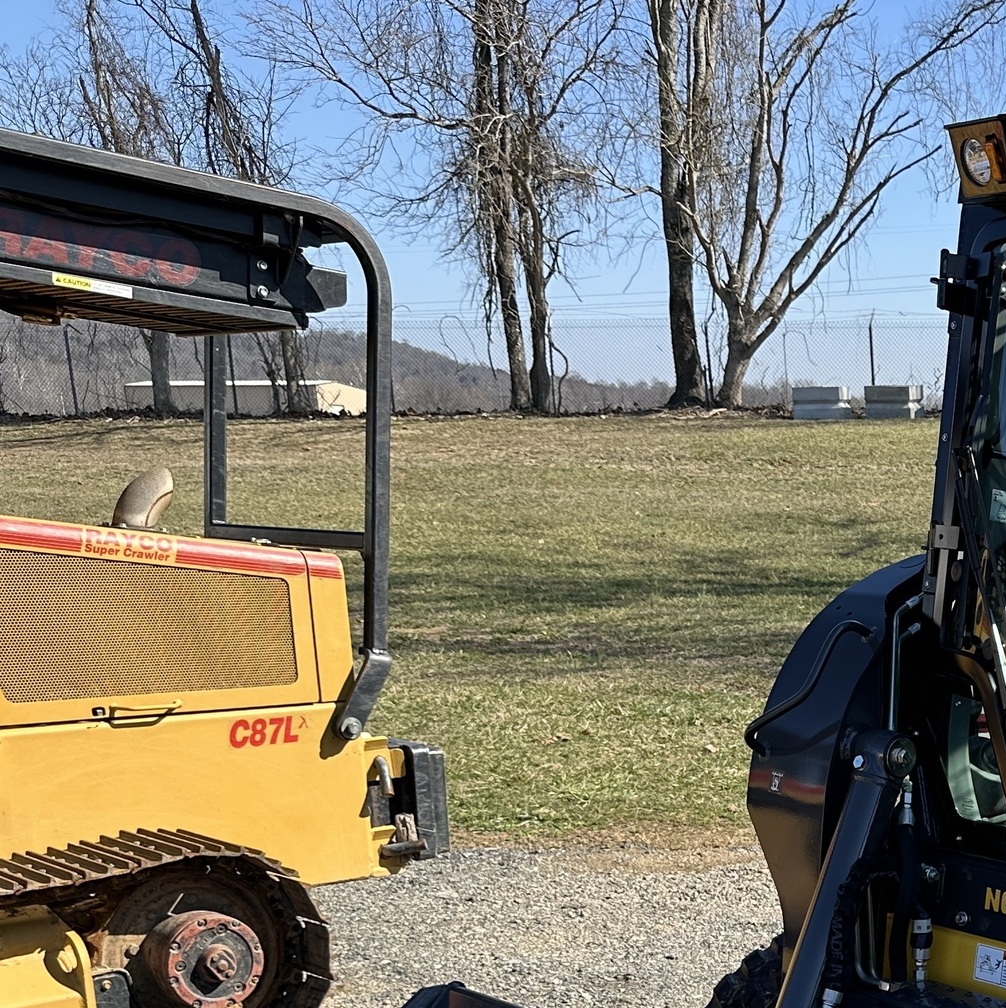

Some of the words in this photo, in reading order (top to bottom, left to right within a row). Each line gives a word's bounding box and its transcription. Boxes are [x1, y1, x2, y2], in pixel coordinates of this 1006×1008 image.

[63, 277, 92, 288] CAUTION
[85, 528, 173, 552] RAYCO
[84, 543, 120, 556] Super
[123, 547, 170, 561] Crawler
[229, 716, 299, 748] C87L
